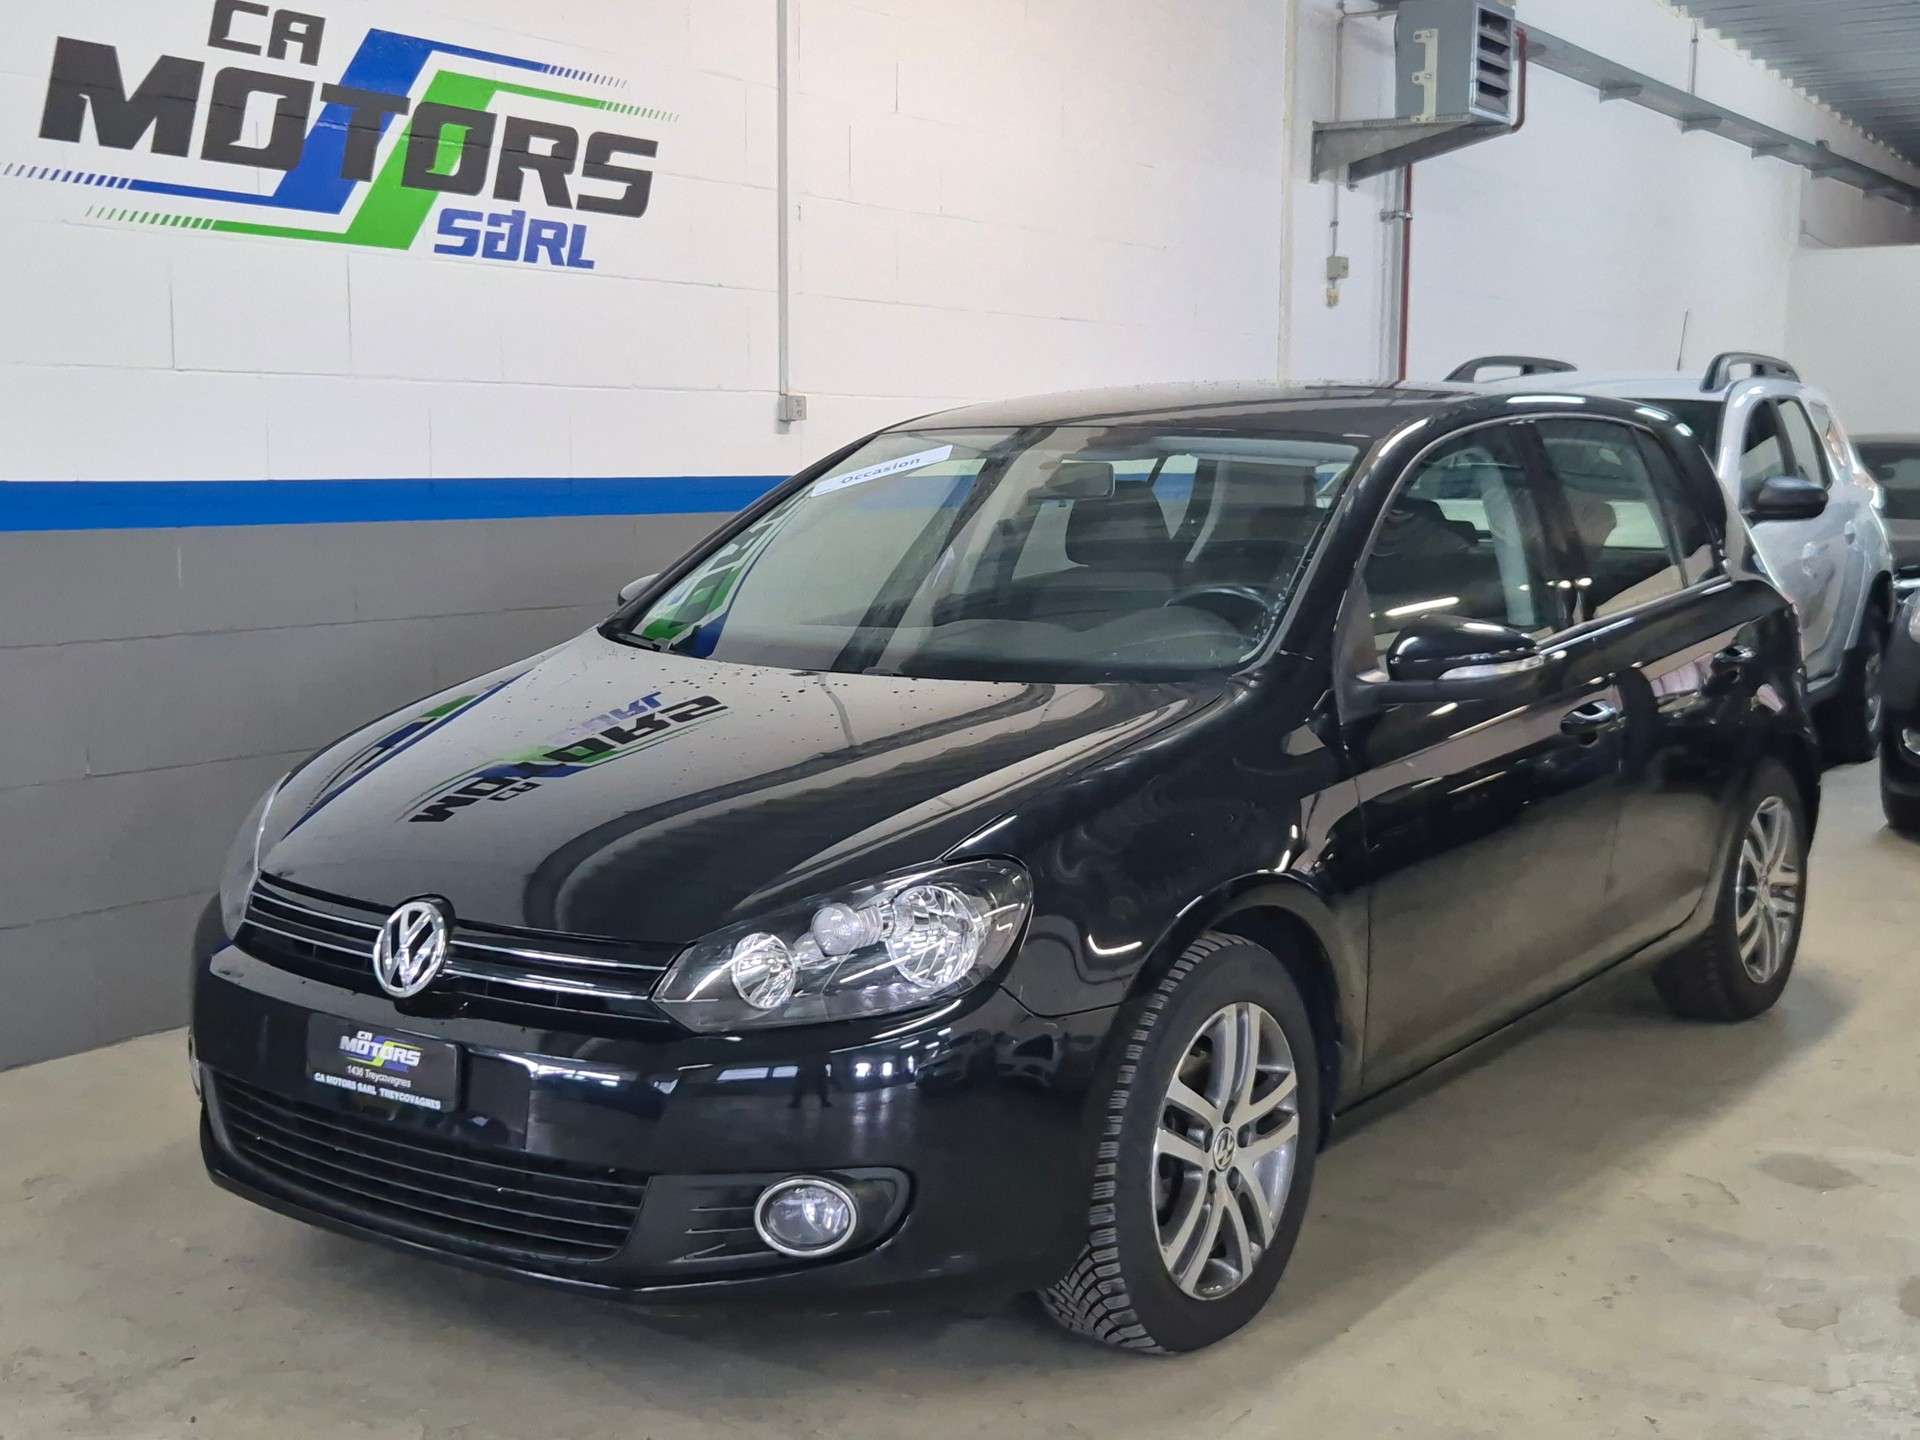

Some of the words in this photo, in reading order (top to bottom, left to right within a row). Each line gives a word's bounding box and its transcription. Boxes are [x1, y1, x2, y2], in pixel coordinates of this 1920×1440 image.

[208, 0, 326, 66] CA
[39, 36, 659, 218] MOTORS
[841, 457, 921, 485] Occasion
[339, 1035, 422, 1067] MOTORS
[313, 1072, 325, 1083] CA
[326, 1075, 357, 1091] MOTORS
